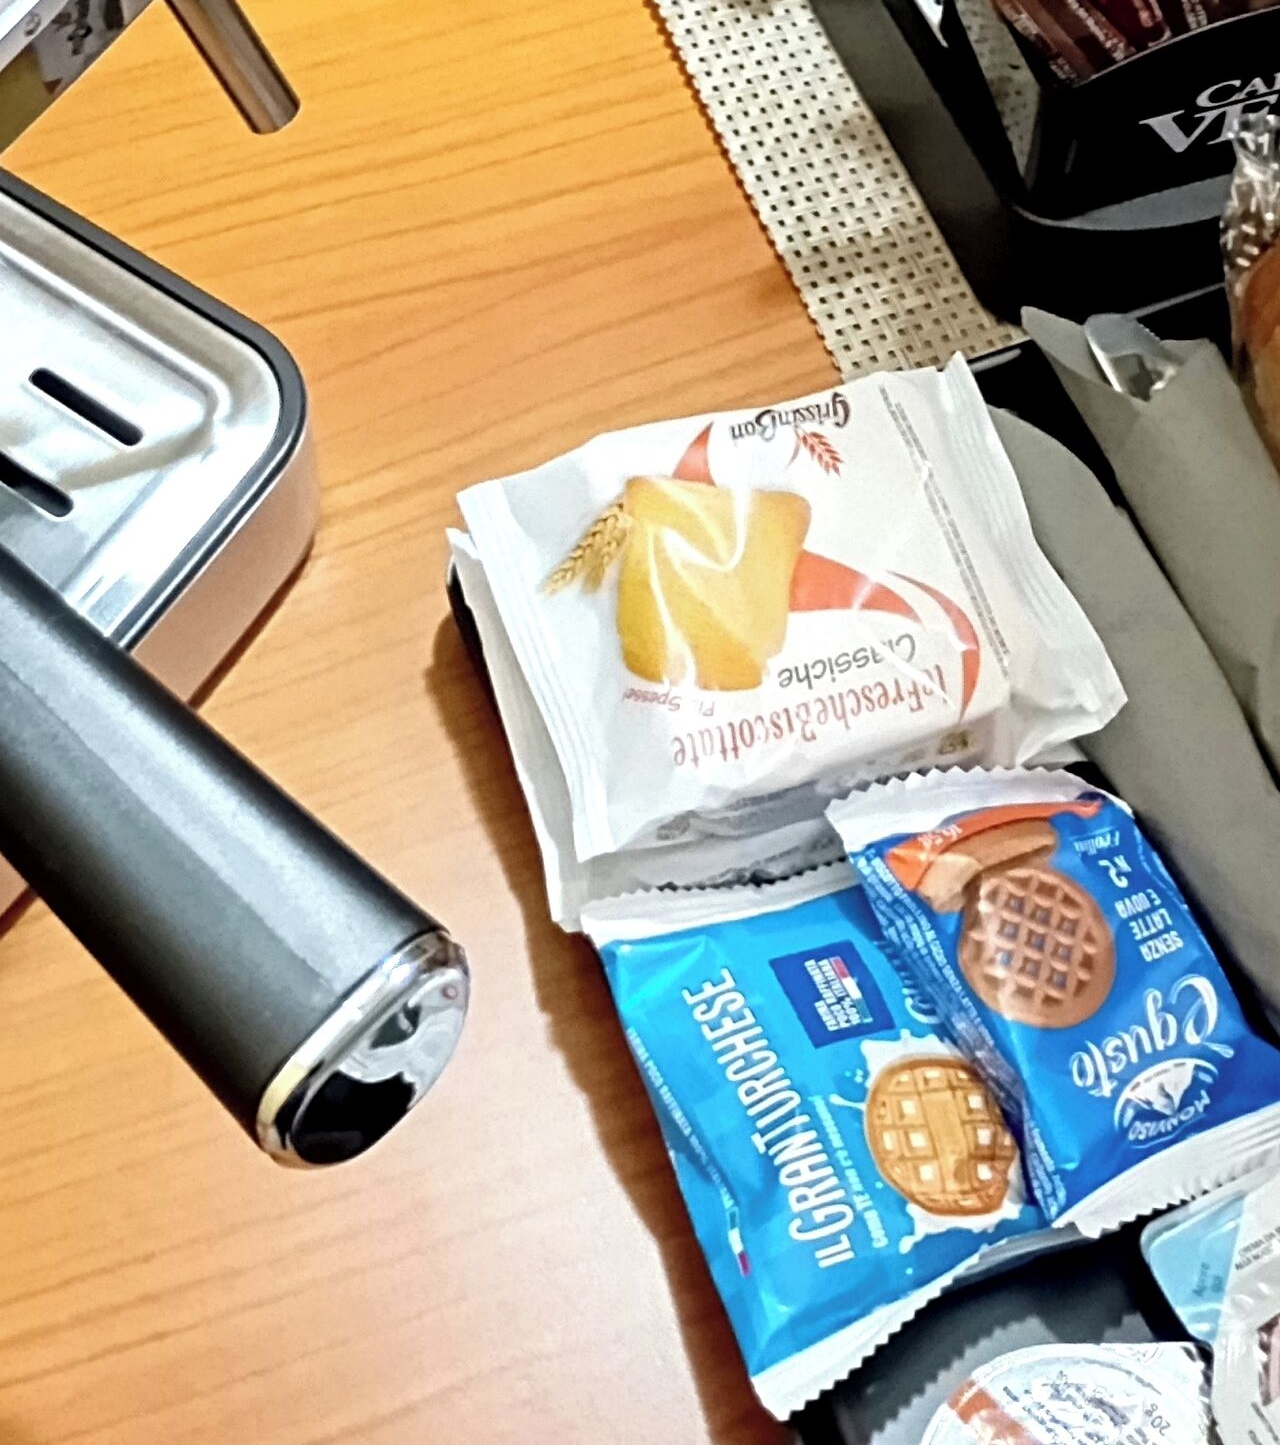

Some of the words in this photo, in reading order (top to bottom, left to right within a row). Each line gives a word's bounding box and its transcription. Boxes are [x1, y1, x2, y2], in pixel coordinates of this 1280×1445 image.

[1115, 891, 1151, 918] UOVA
[1129, 908, 1172, 941] LATTE
[1139, 930, 1184, 962] SENZA
